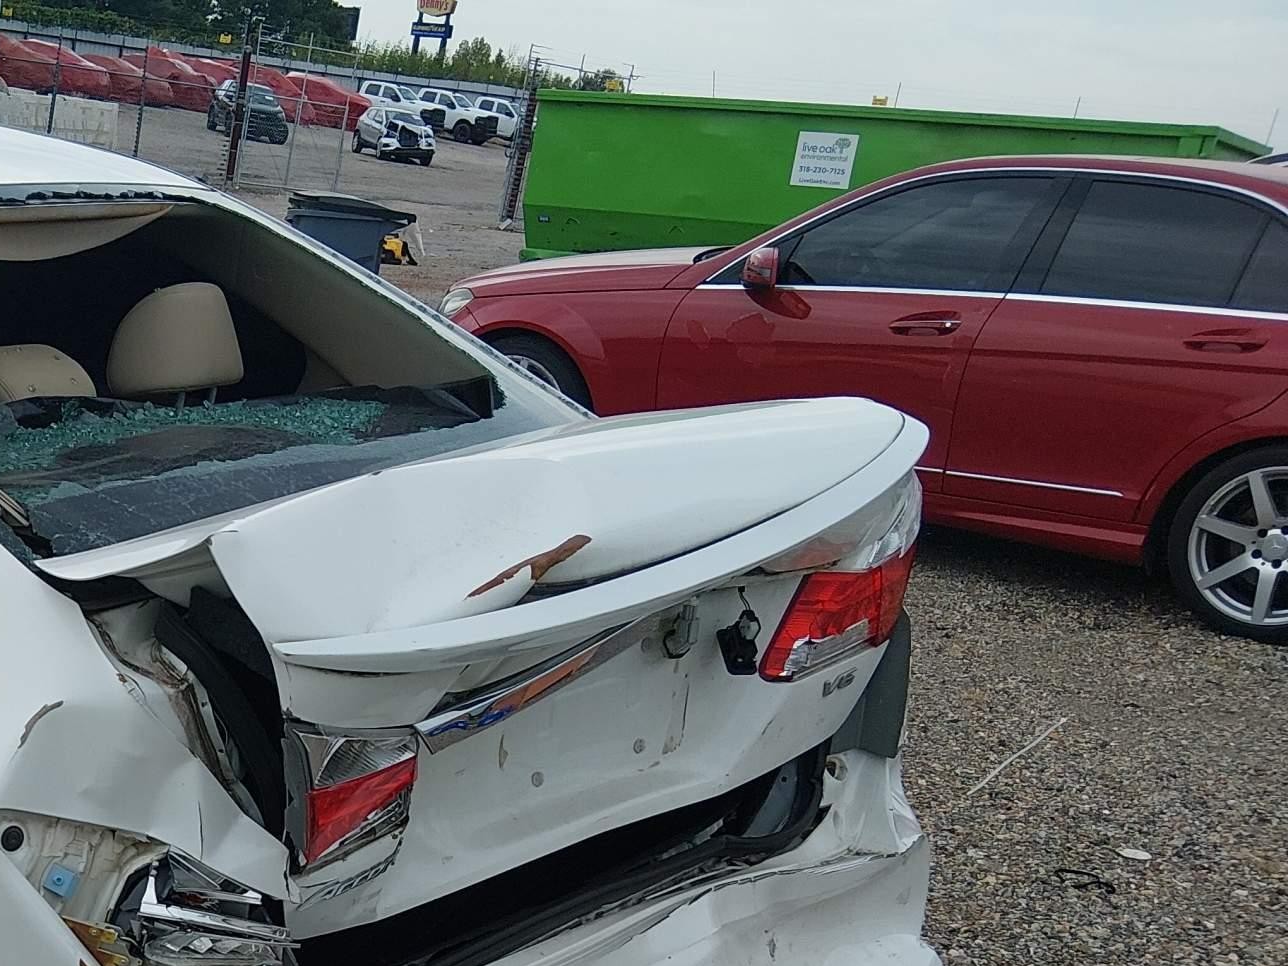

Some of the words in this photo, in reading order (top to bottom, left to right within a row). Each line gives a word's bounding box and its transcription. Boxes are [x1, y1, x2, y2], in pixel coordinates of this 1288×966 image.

[420, 0, 449, 11] Denny's
[802, 142, 818, 153] live
[818, 143, 837, 154] oak
[800, 153, 848, 162] environmental
[822, 666, 857, 697] V6
